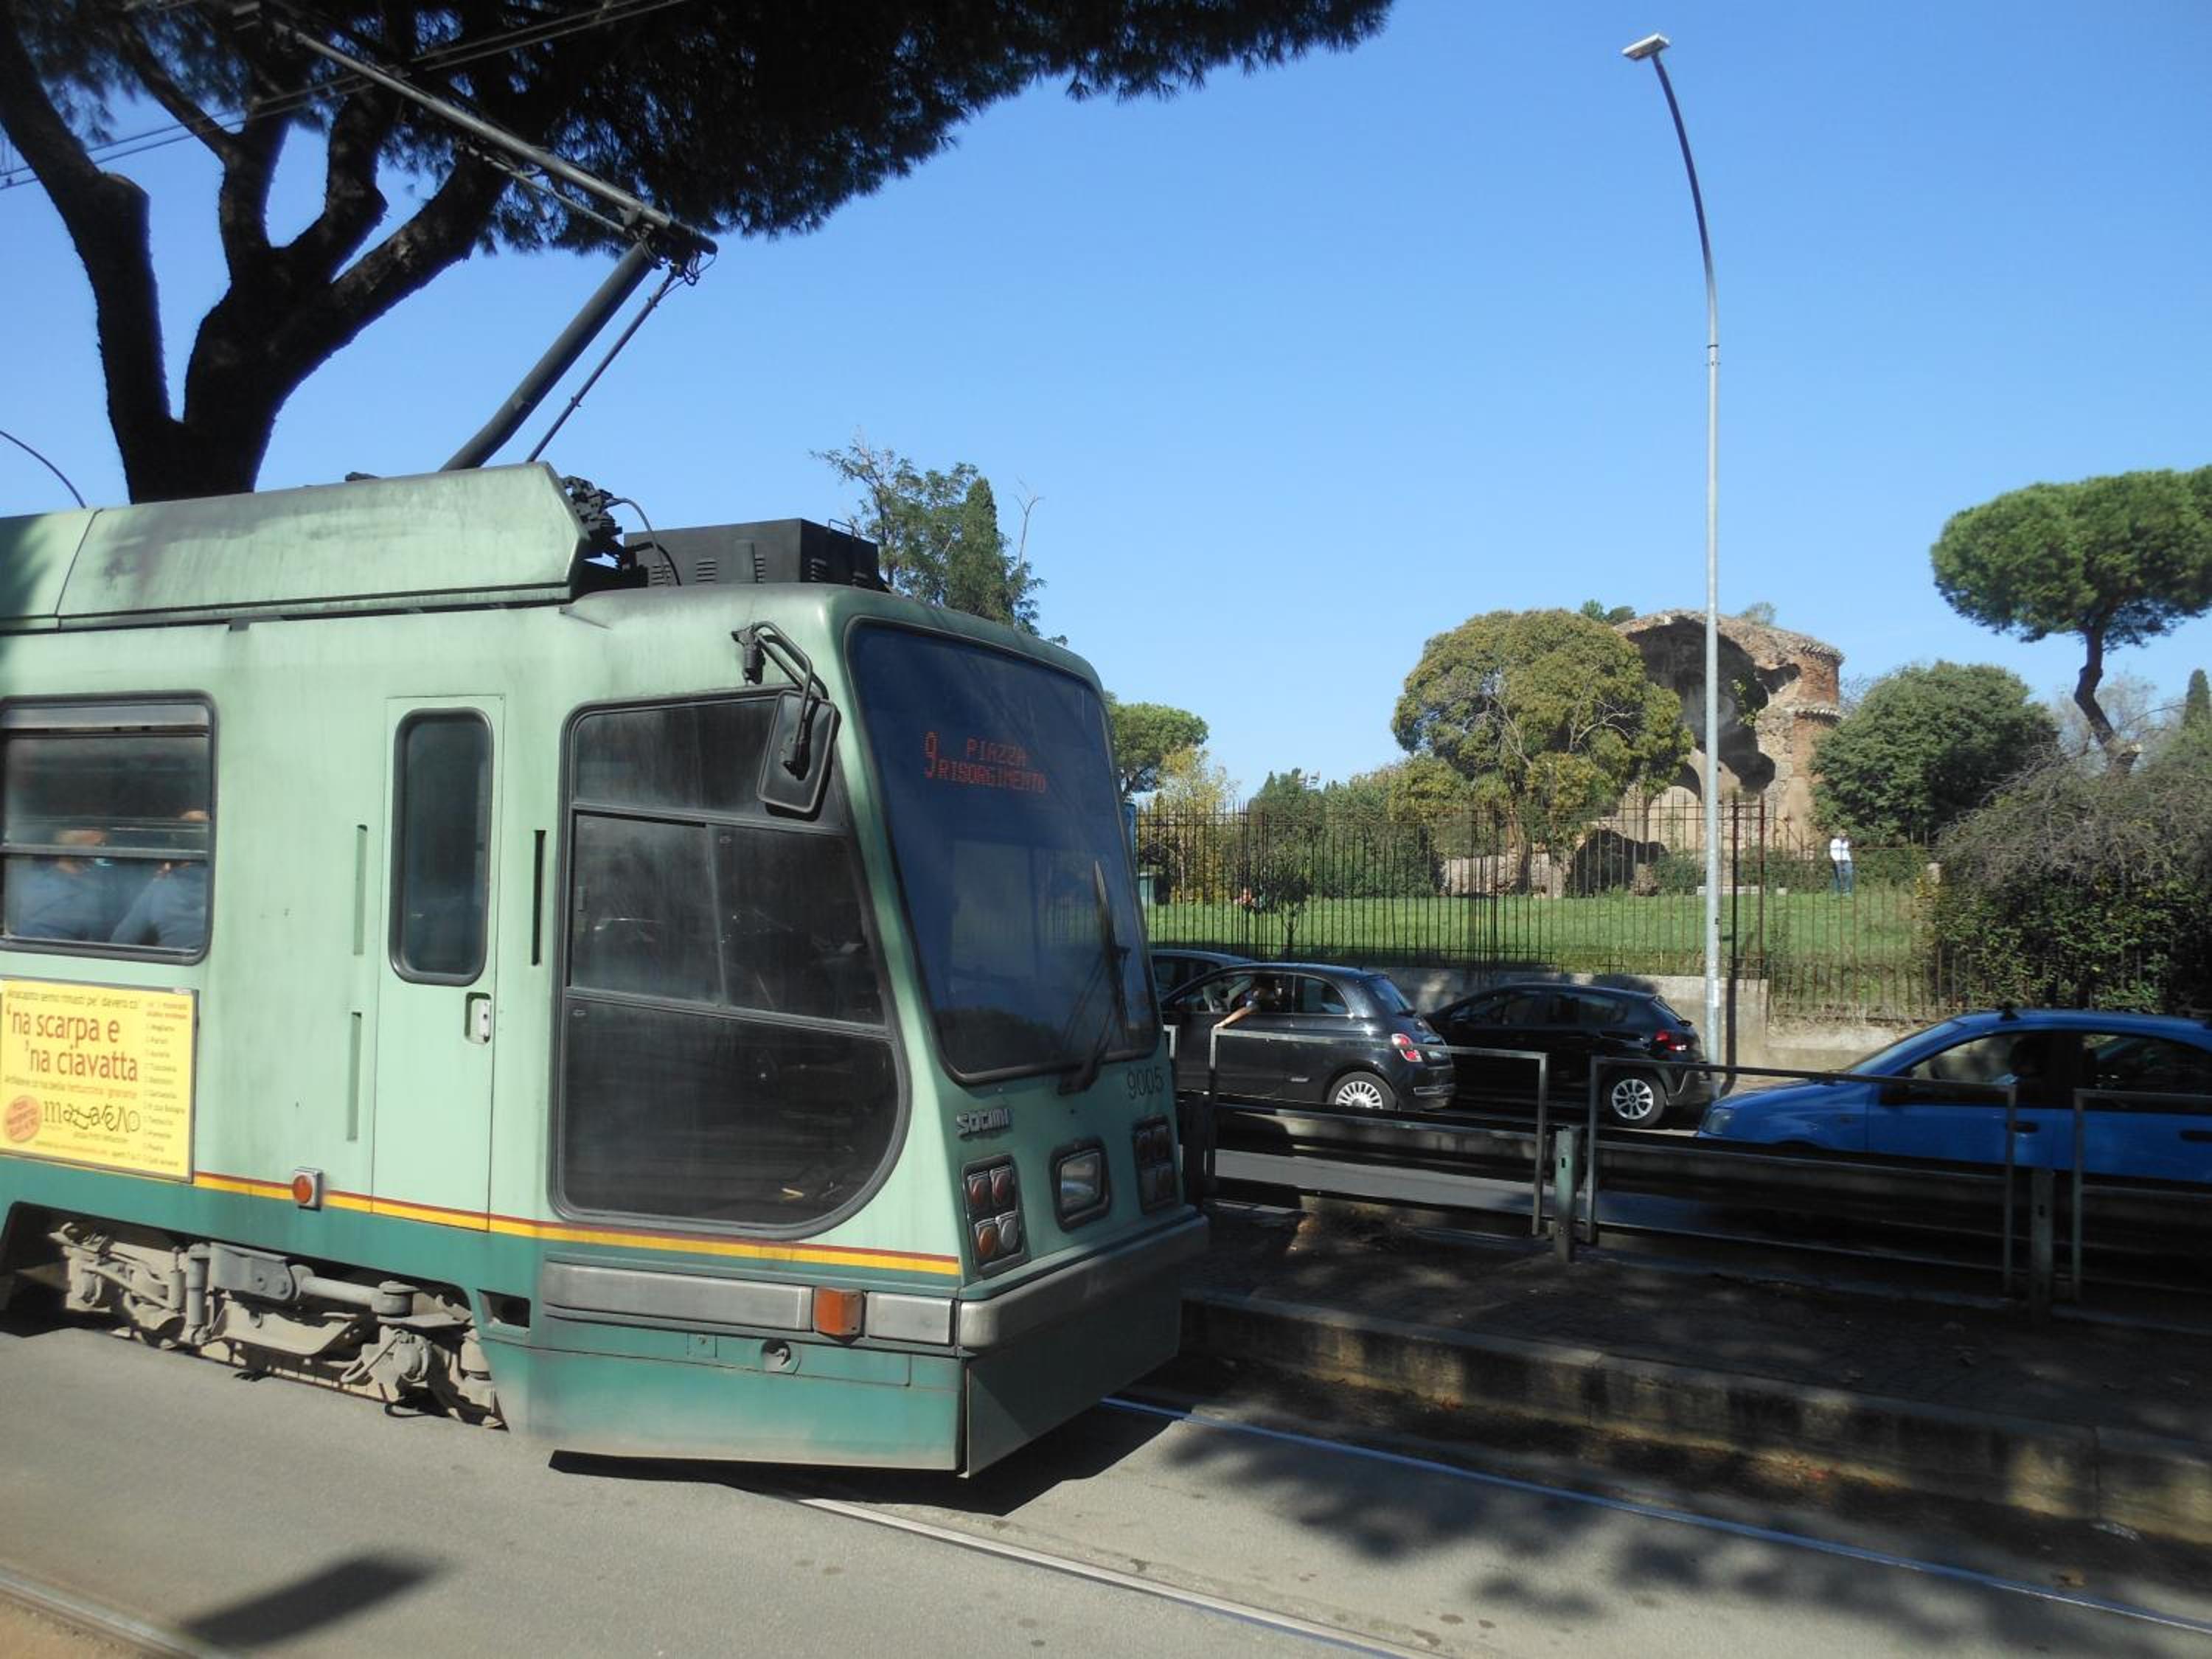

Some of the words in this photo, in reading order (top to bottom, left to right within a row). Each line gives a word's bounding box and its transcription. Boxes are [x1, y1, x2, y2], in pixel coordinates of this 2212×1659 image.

[925, 731, 938, 779] 9
[967, 737, 1027, 766] PIAZZA
[937, 759, 1046, 793] RISORGIMENTO
[36, 1013, 100, 1048] scarpa
[107, 1020, 121, 1043] e
[57, 1044, 139, 1082] ciavatta
[1127, 1066, 1165, 1099] 9005
